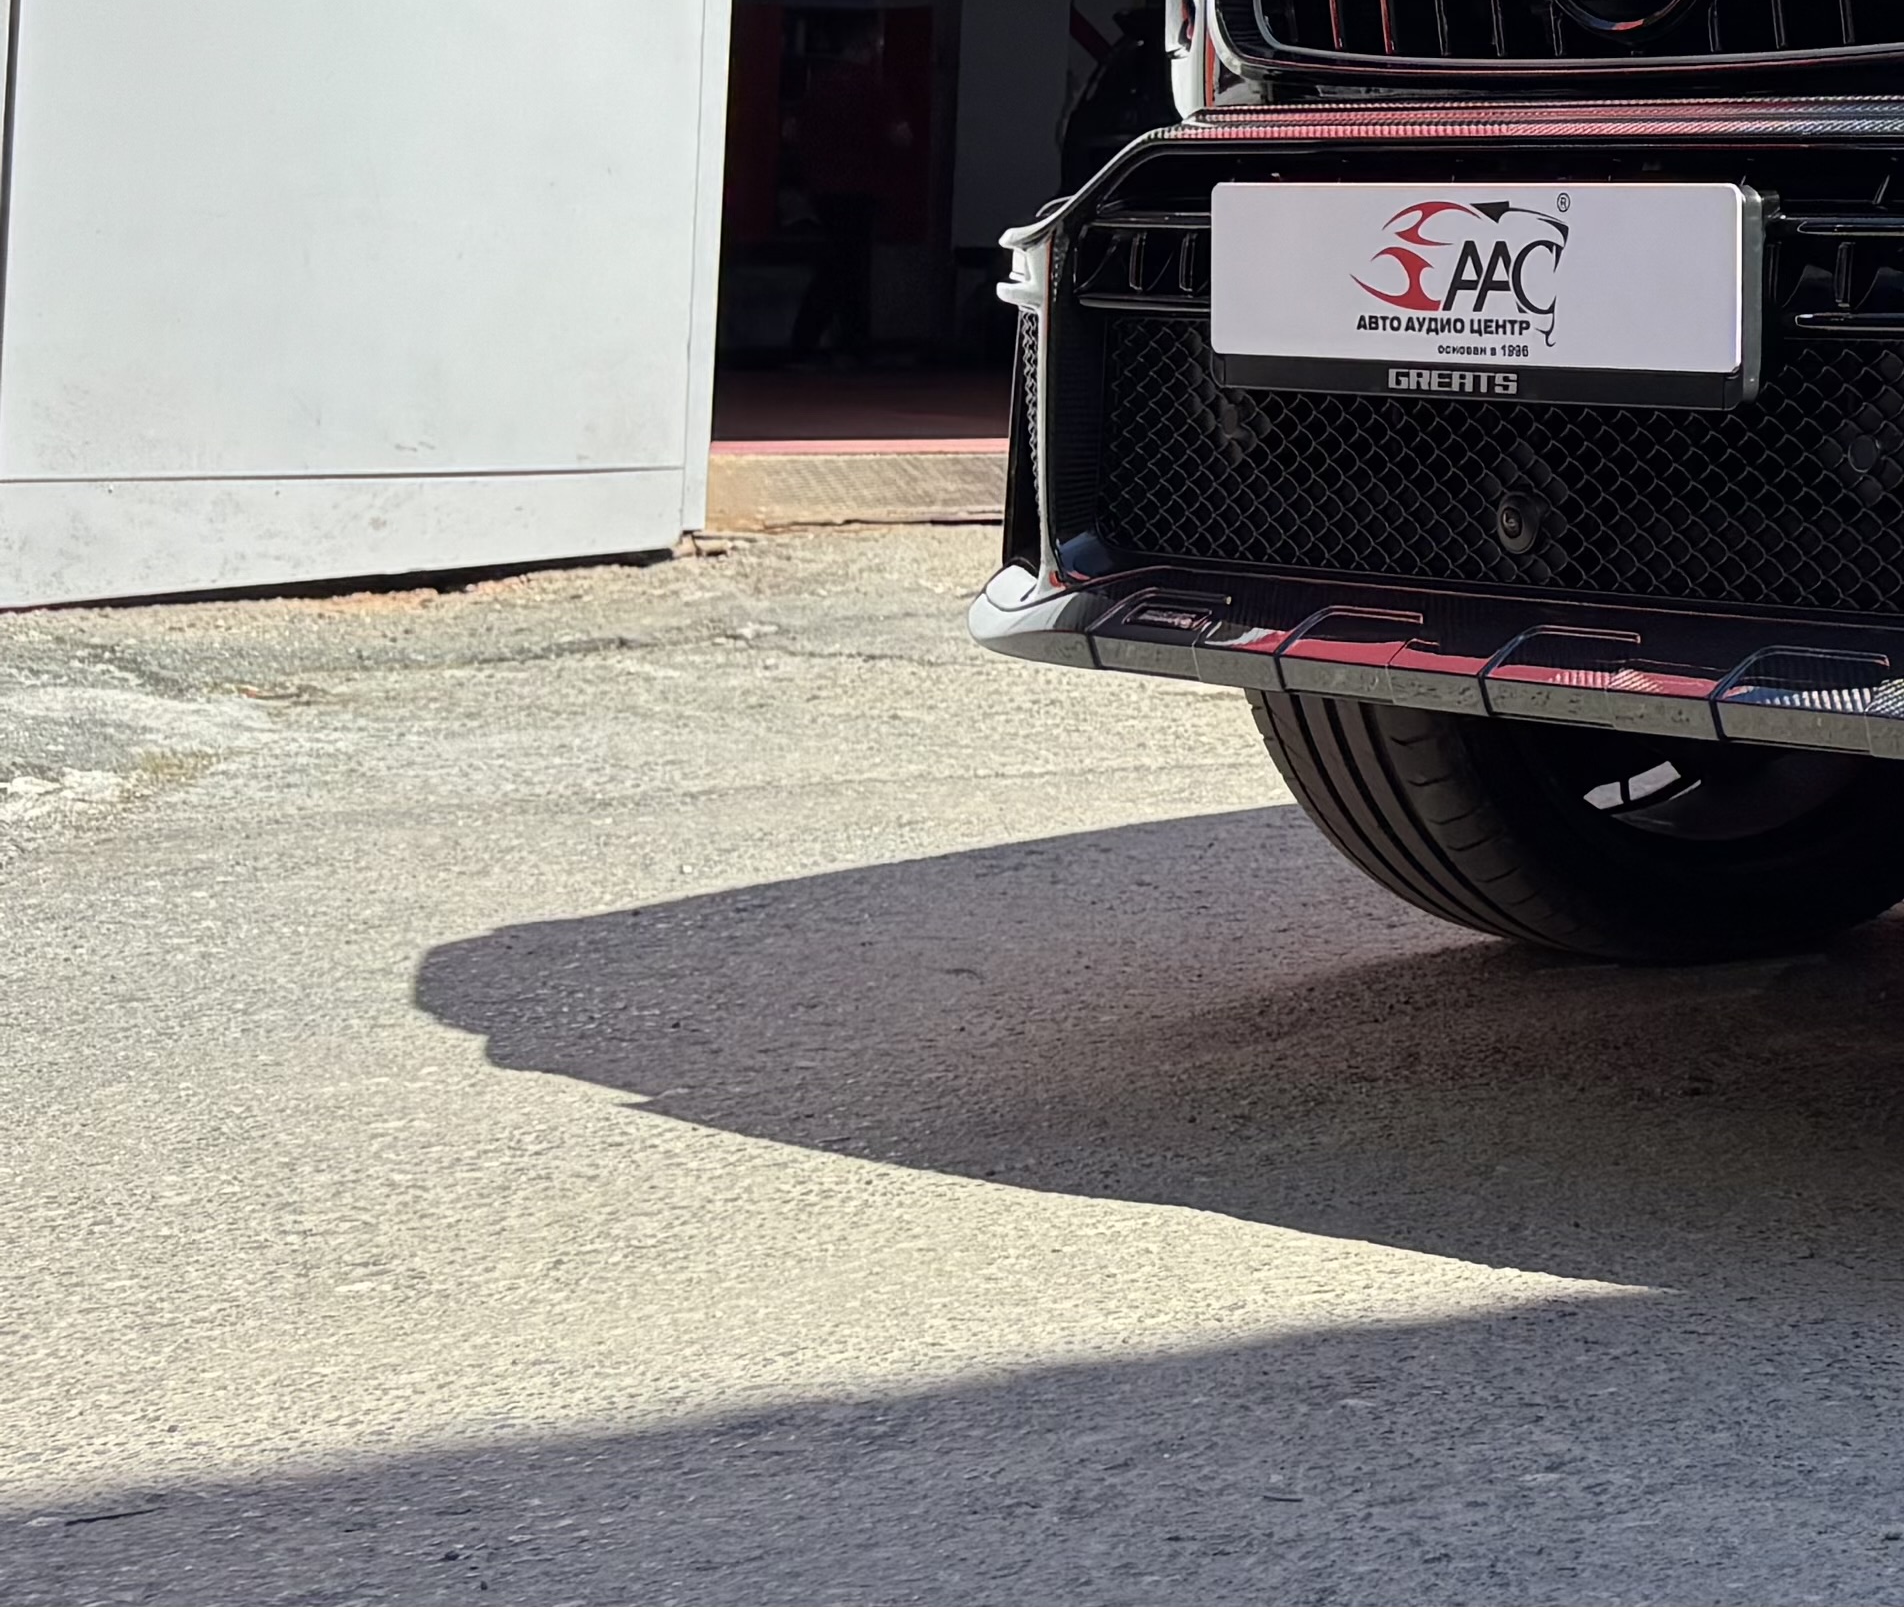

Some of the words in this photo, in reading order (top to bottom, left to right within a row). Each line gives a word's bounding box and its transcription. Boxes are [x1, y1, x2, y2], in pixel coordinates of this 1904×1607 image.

[1356, 314, 1402, 332] АВТО
[1404, 316, 1465, 335] АУДИО
[1469, 319, 1531, 337] ЦЕНТР
[1437, 345, 1487, 356] основан
[1388, 368, 1518, 395] GREATS
